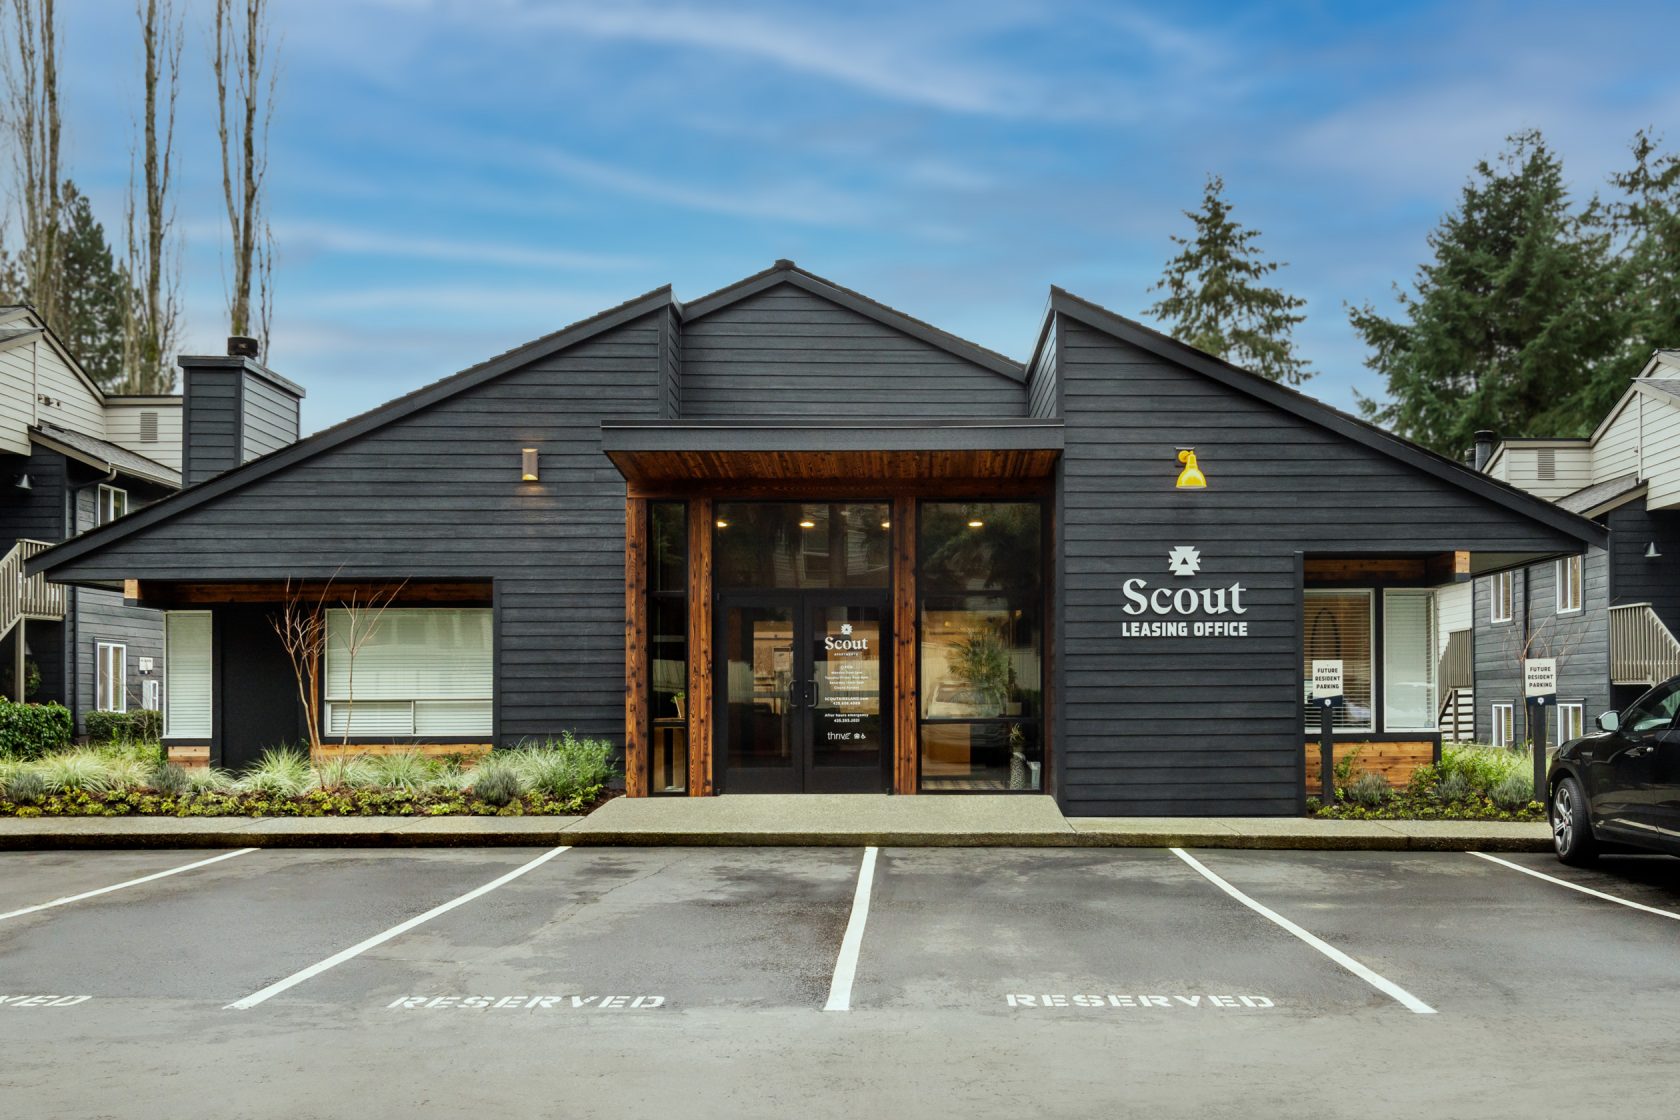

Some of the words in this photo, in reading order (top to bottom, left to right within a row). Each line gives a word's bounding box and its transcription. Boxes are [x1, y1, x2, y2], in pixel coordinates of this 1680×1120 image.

[1122, 578, 1248, 615] Scout
[1122, 622, 1188, 637] LEASING
[1193, 622, 1248, 637] OFFICE
[824, 636, 869, 650] Scout
[386, 995, 666, 1009] RESERVED
[1006, 993, 1275, 1008] RESERVED
